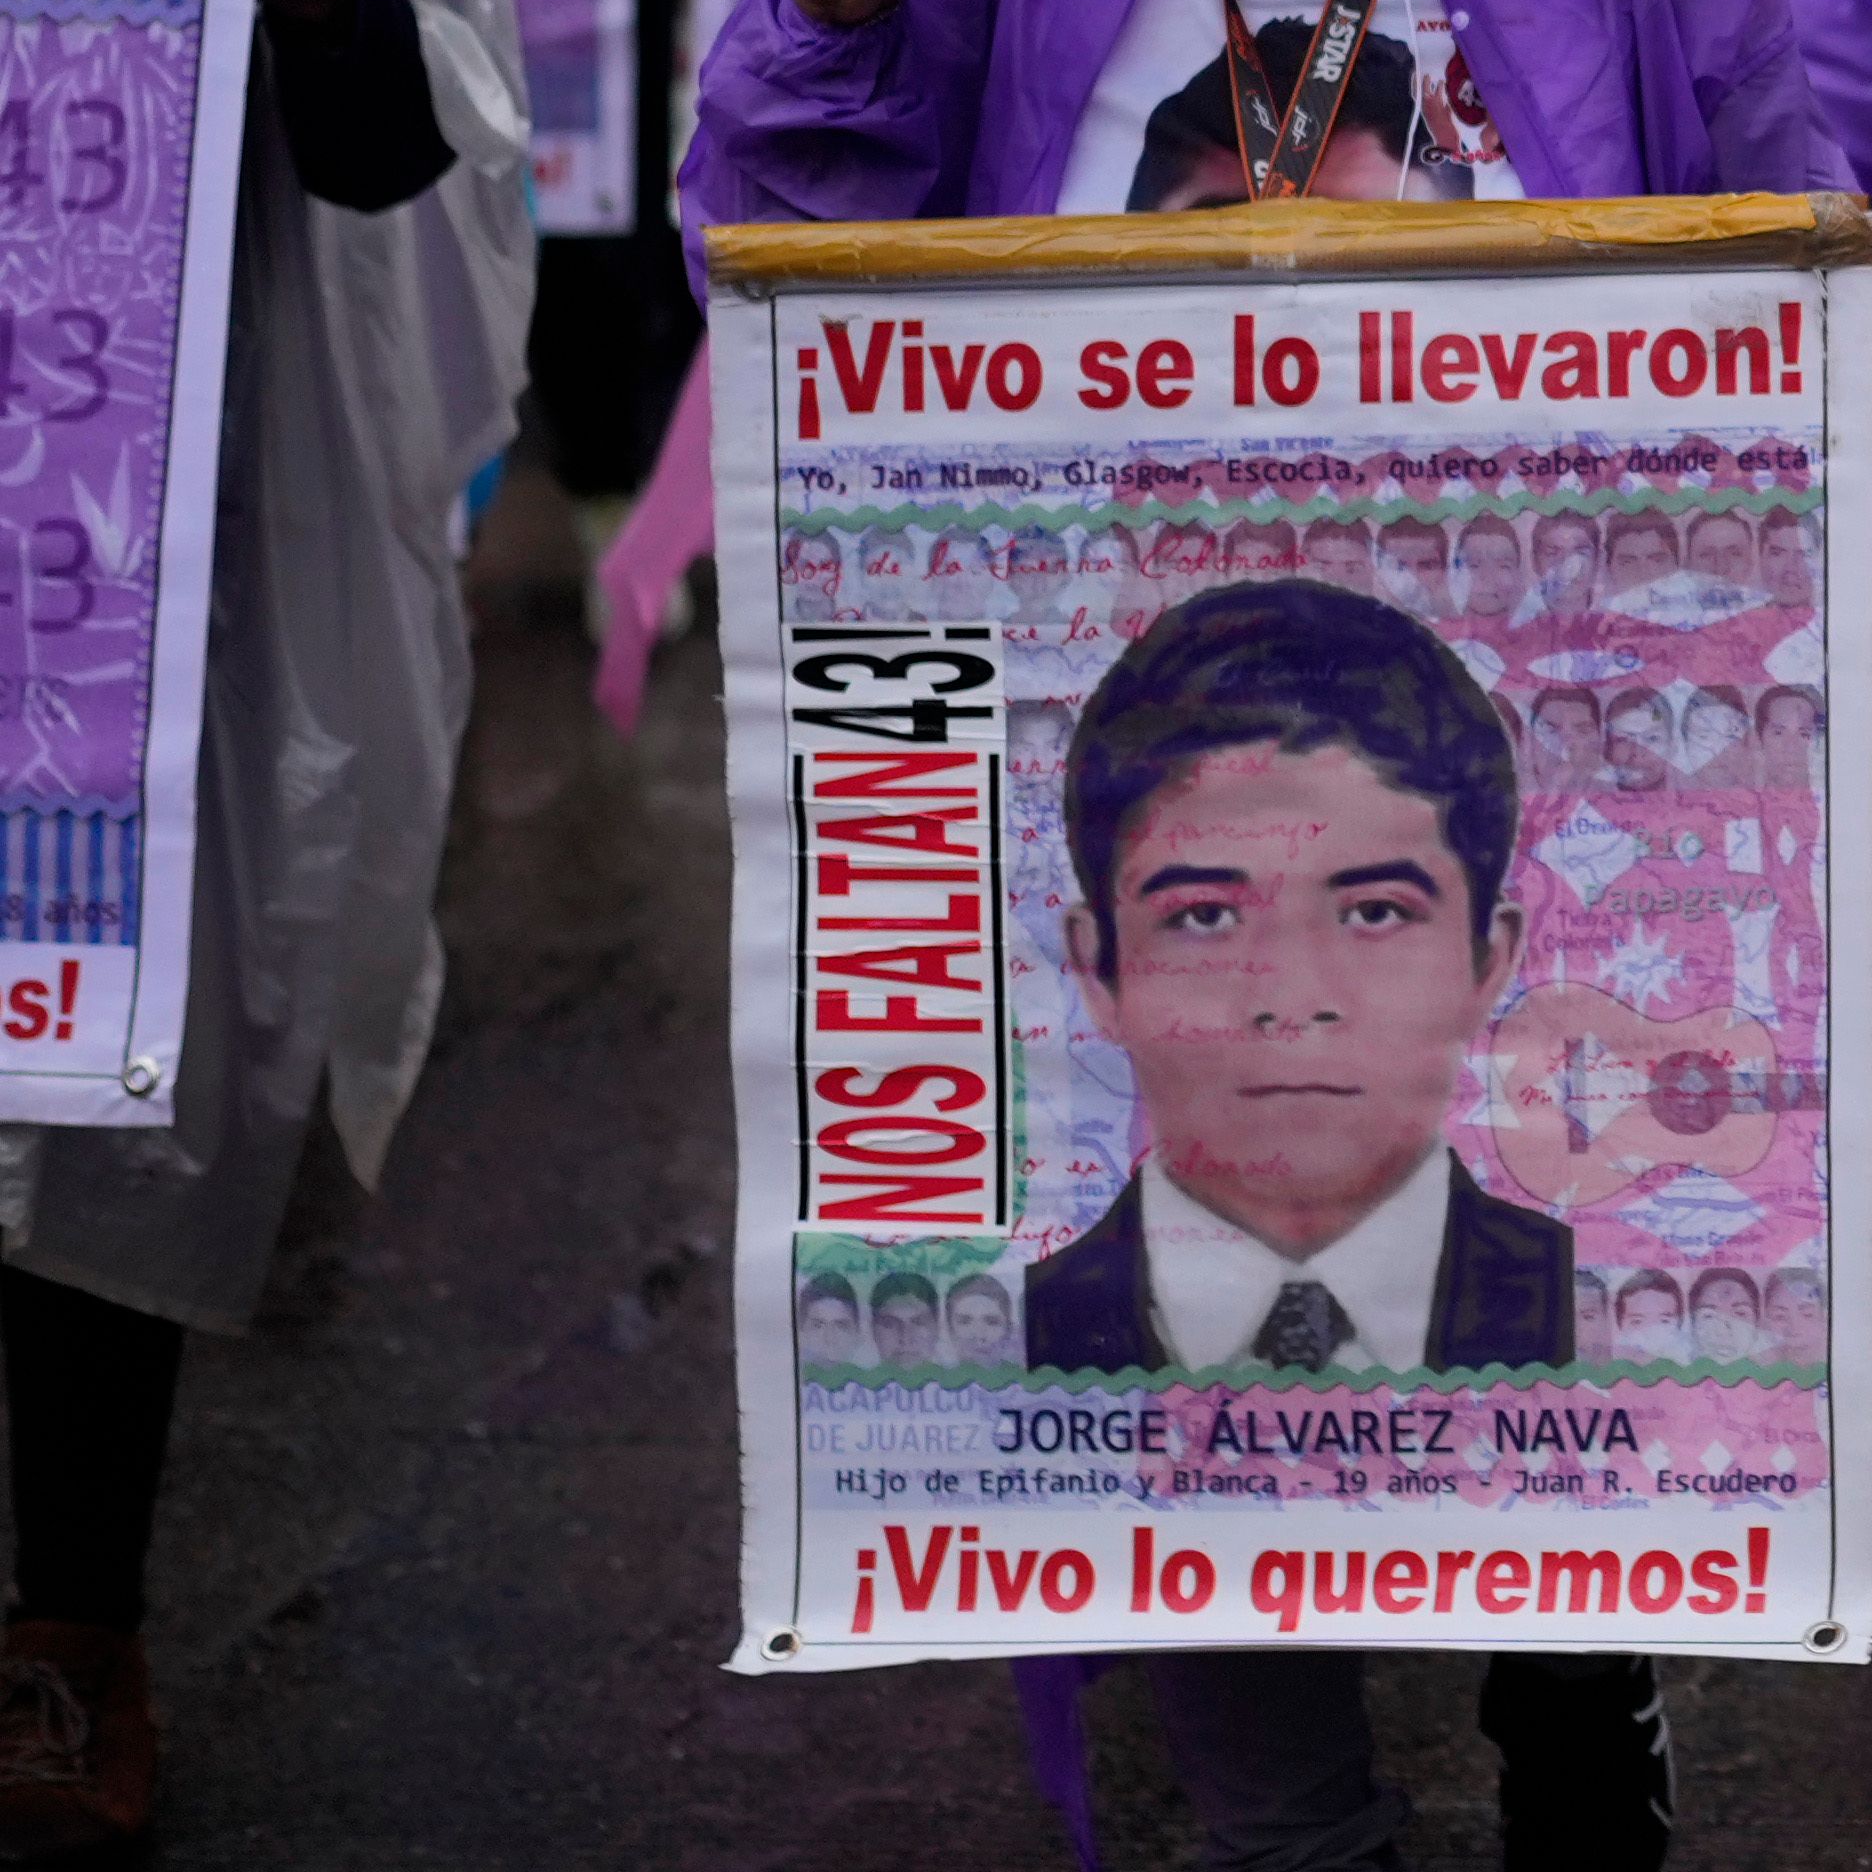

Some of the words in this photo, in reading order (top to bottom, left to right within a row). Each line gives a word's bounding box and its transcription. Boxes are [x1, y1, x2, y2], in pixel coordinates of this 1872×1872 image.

[796, 321, 1042, 440] ¡Vivo
[1079, 341, 1193, 412] se
[1233, 314, 1321, 407] lo
[1357, 302, 1803, 405] llevaron!
[798, 465, 848, 494] Yo,
[871, 465, 923, 490] Jan
[940, 461, 1044, 492] Nimmo,
[1063, 459, 1204, 489] Glasgow,
[1227, 455, 1366, 484] Escocia,
[1388, 453, 1499, 482] quiero
[1517, 449, 1608, 477] saber
[1626, 446, 1719, 474] dónde
[1737, 444, 1810, 471] está
[812, 752, 984, 1033] FALTAN
[816, 1064, 988, 1224] NOS
[999, 1409, 1166, 1453] JORGE
[1208, 1399, 1454, 1454] ÁLVAREZ
[1496, 1409, 1639, 1453] NAVA
[836, 1469, 906, 1500] Hijo
[925, 1469, 959, 1494] de
[980, 1468, 1120, 1499] Epifanio
[1137, 1473, 1156, 1500] y
[1172, 1468, 1278, 1495] Blanca
[1334, 1470, 1367, 1495] 19
[1388, 1468, 1457, 1495] años
[1514, 1469, 1583, 1495] Juan
[1604, 1469, 1634, 1495] R.
[1657, 1468, 1798, 1495] Escudero
[850, 1525, 1096, 1634] ¡Vivo
[1130, 1526, 1217, 1615] lo
[1249, 1526, 1771, 1634] queremos!
